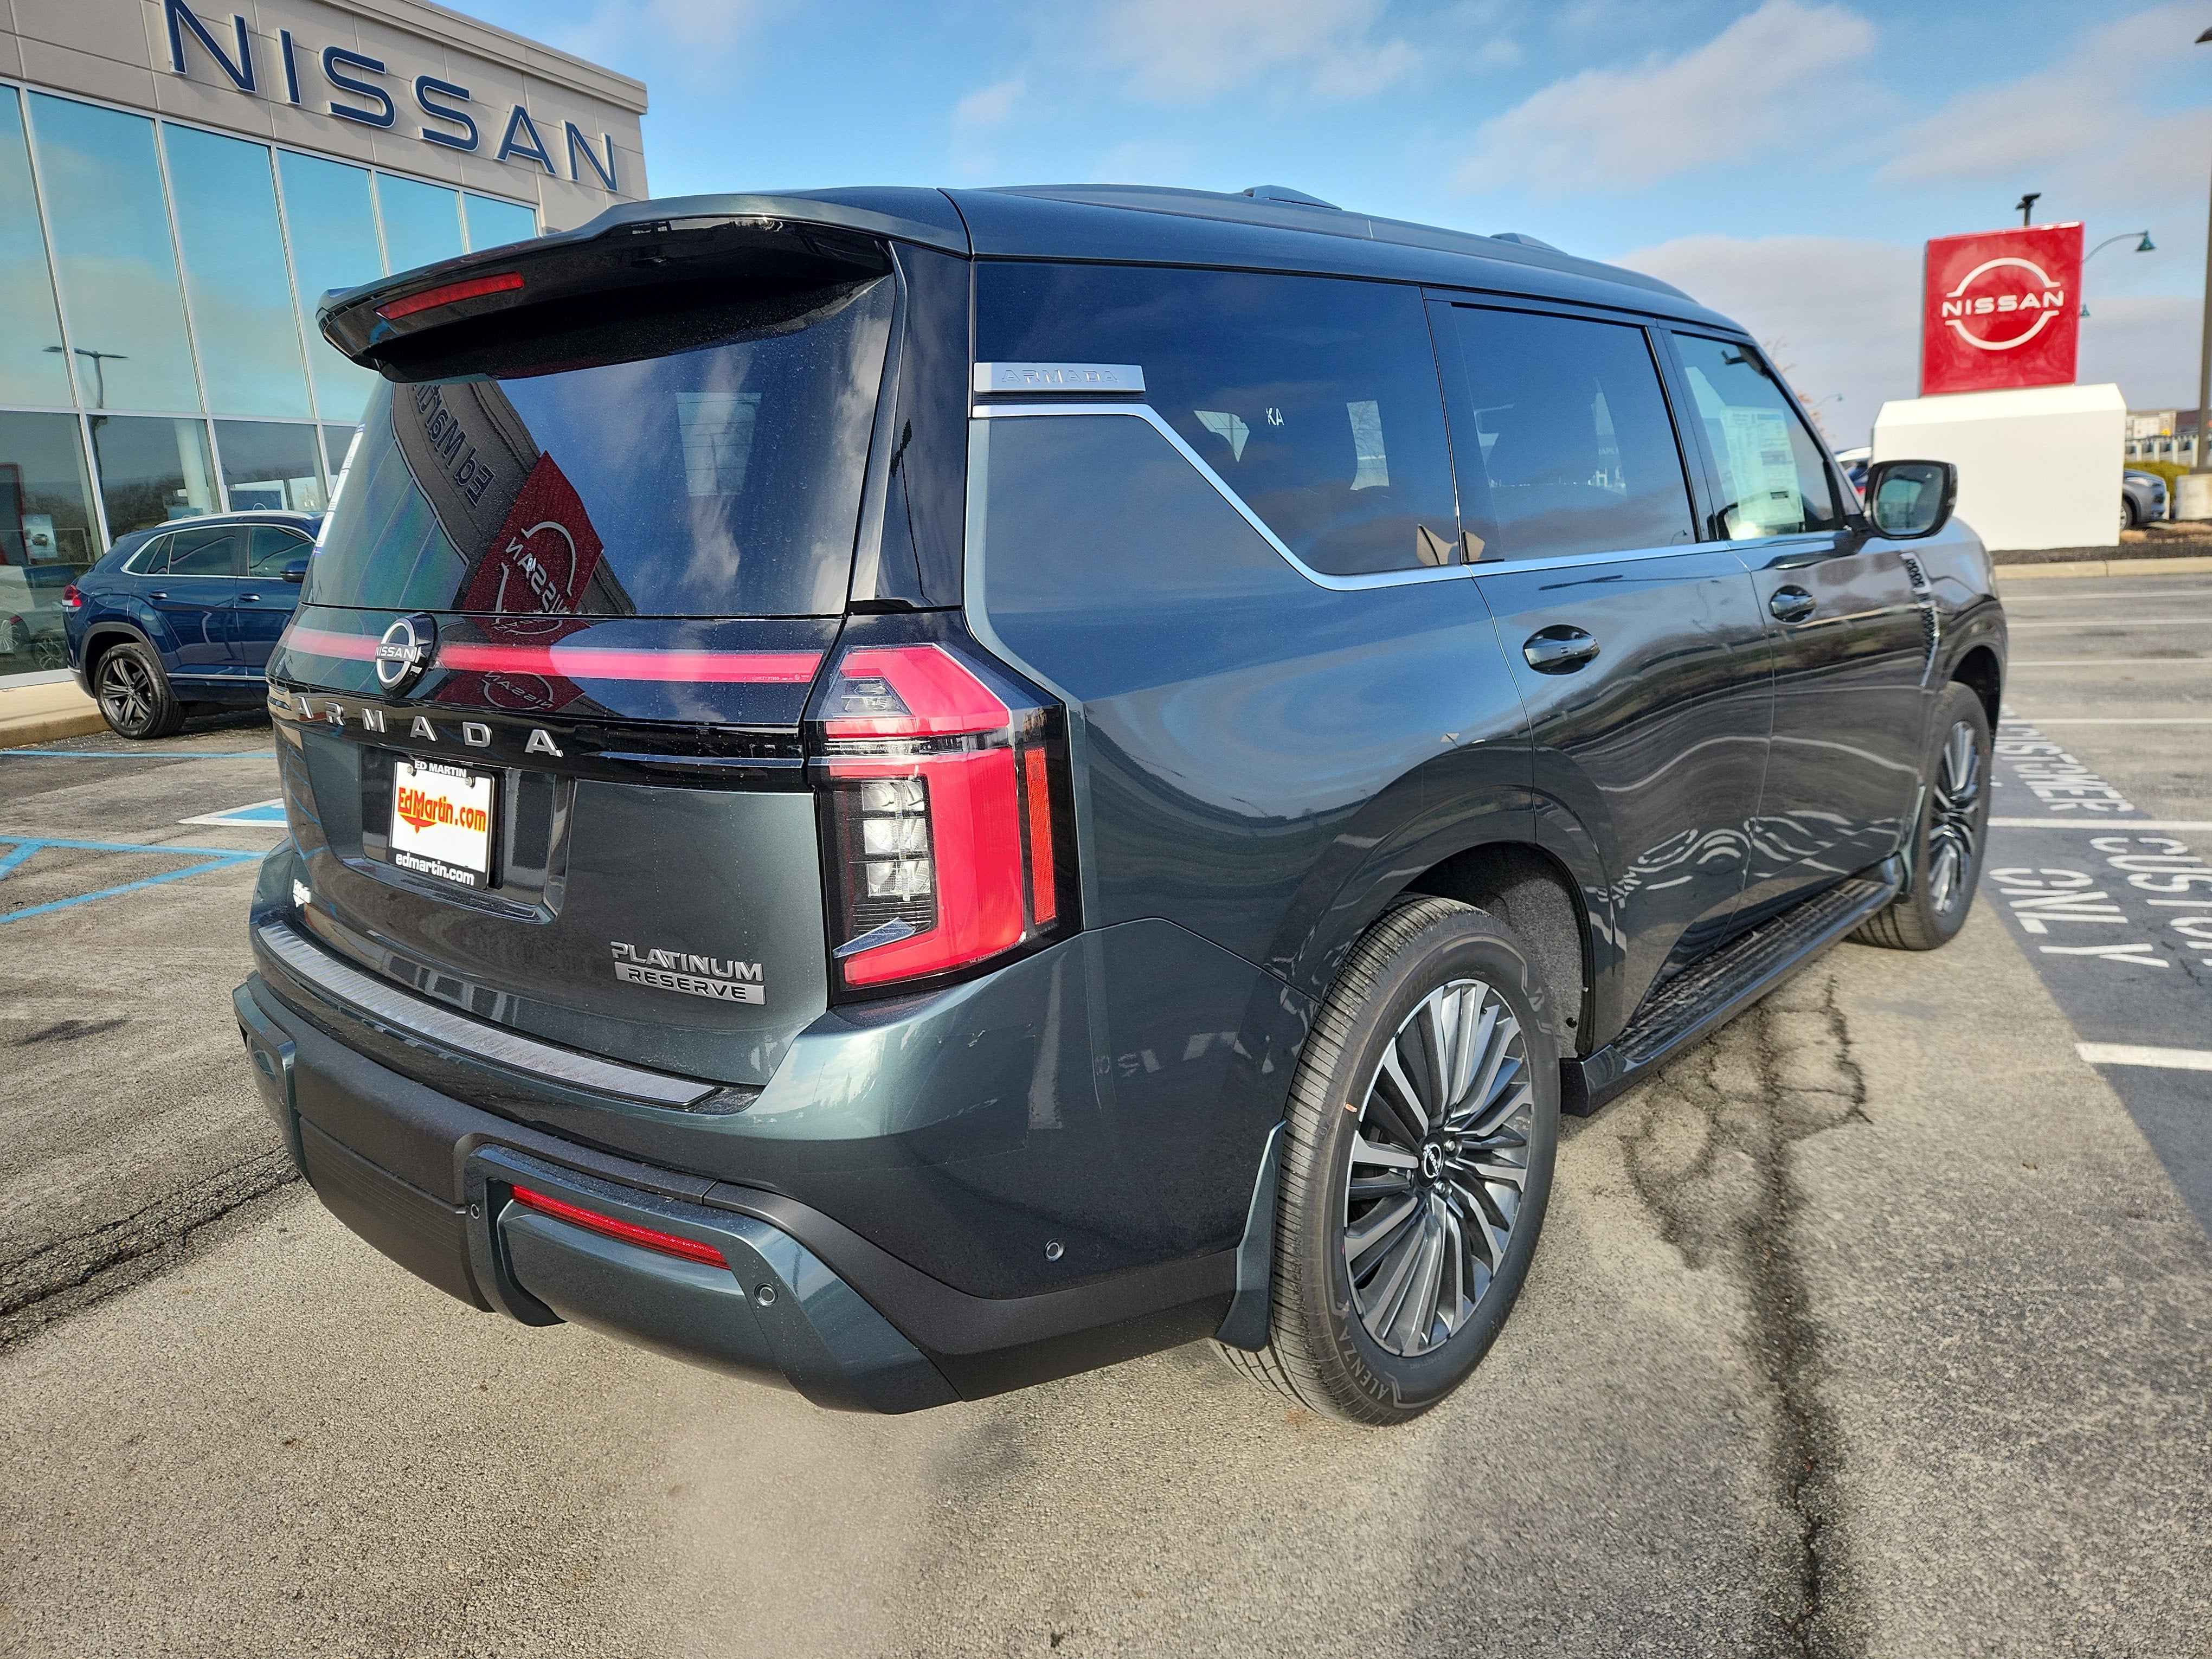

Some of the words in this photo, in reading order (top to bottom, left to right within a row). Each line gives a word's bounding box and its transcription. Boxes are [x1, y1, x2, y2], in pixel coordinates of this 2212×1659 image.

[162, 0, 618, 191] NISSAN
[1942, 290, 2064, 318] NISSAN
[1001, 370, 1120, 383] ARMADA
[375, 646, 414, 659] NISSAN
[297, 697, 563, 757] ARMADA
[414, 760, 427, 770] ED
[429, 763, 467, 778] MARTIN
[395, 852, 475, 886] edmartin.com
[1989, 867, 2170, 968] ONLY
[610, 941, 764, 982] PLATINUM
[627, 968, 747, 1000] RESERVE
[1338, 1324, 1390, 1400] ALENZA
